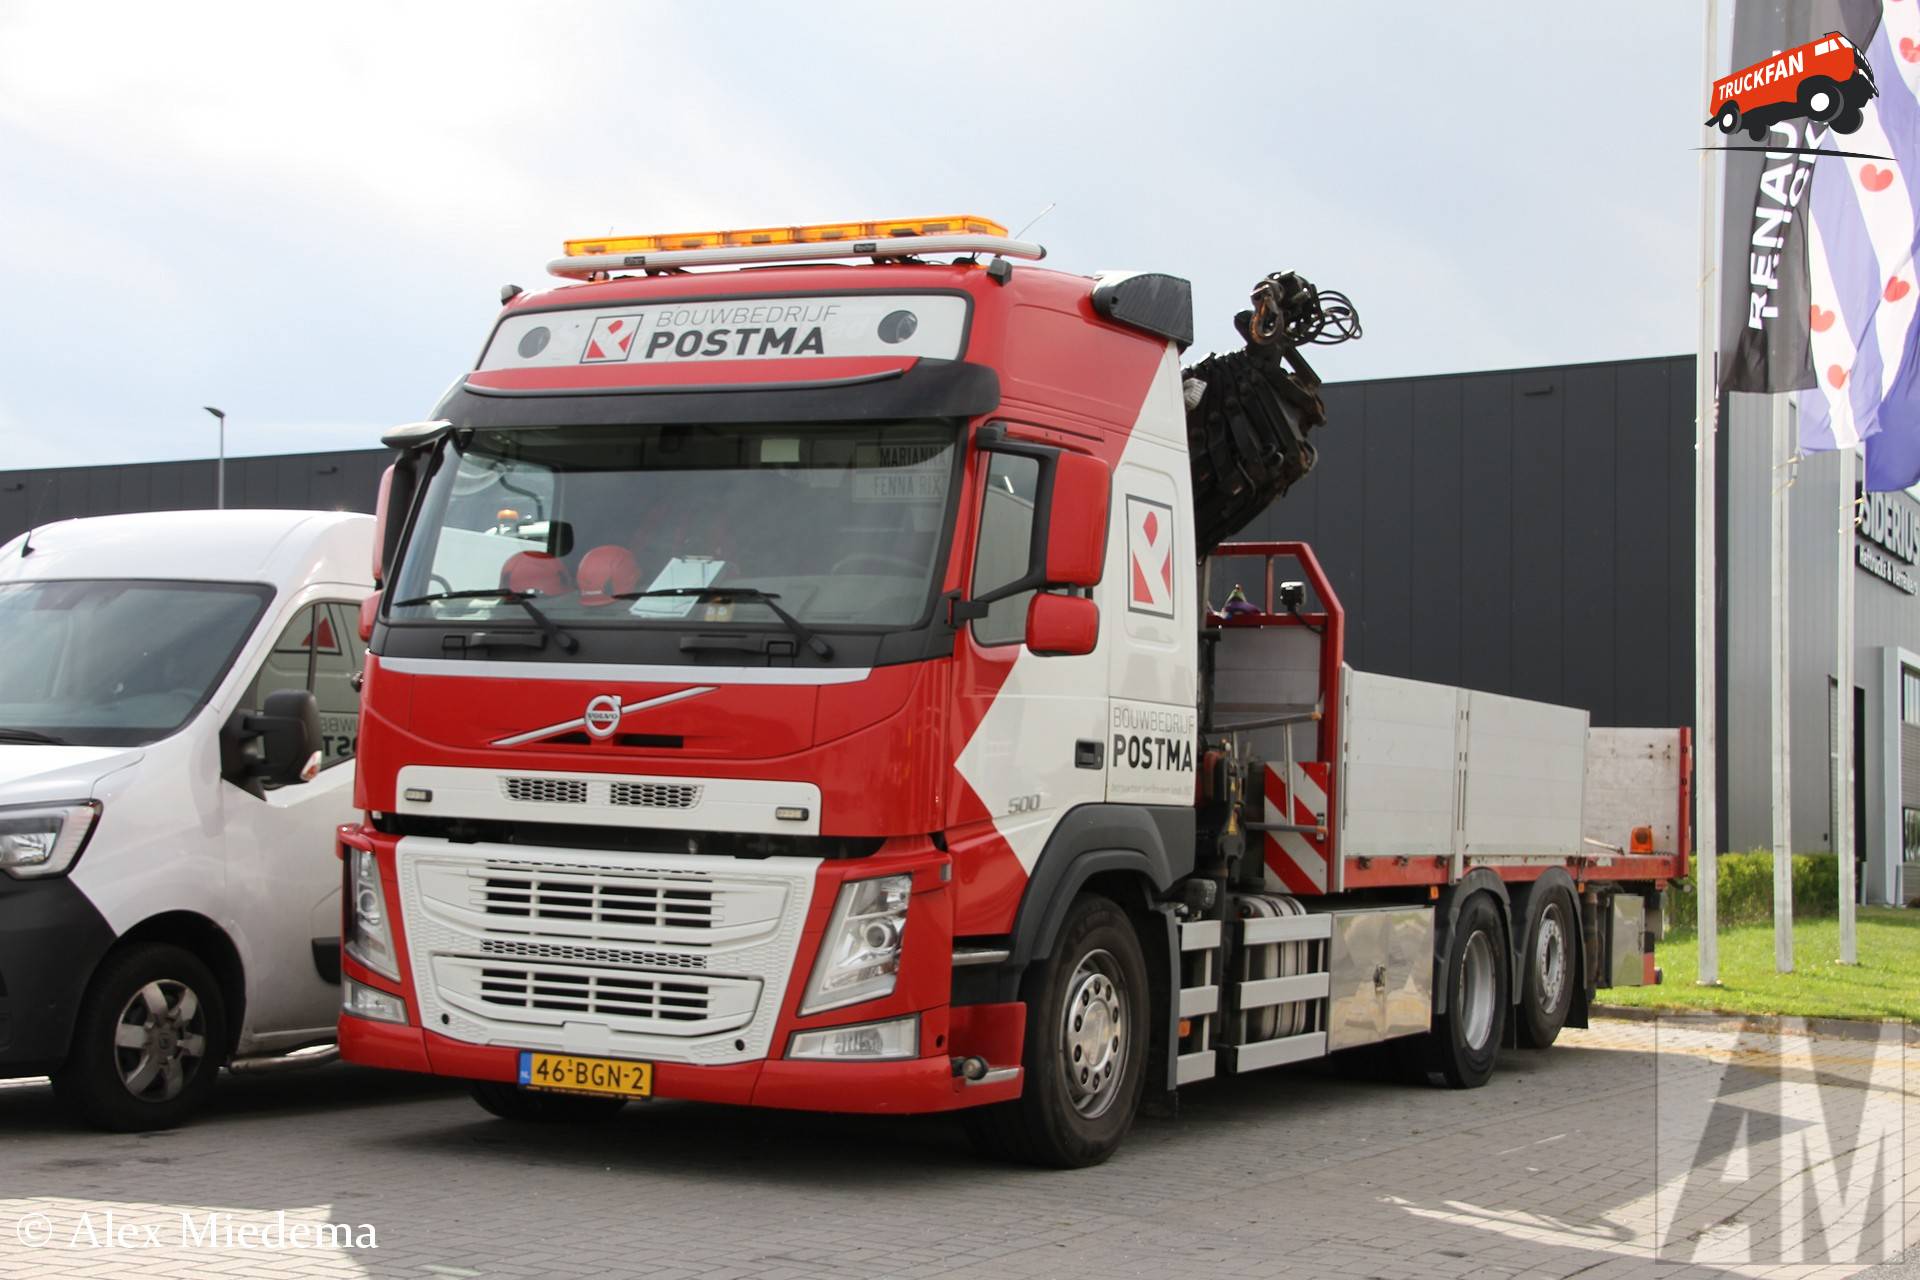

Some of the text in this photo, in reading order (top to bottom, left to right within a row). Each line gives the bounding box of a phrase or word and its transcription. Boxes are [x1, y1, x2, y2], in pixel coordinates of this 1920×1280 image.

[1748, 119, 1799, 330] RENAU
[656, 305, 841, 328] BOUWBEDRIJF
[645, 326, 824, 359] POSTMA
[874, 475, 914, 497] FENNA
[1113, 706, 1195, 736] BOUWBEDRIJF
[1113, 733, 1193, 772] POSTMA
[1008, 794, 1040, 815] 500
